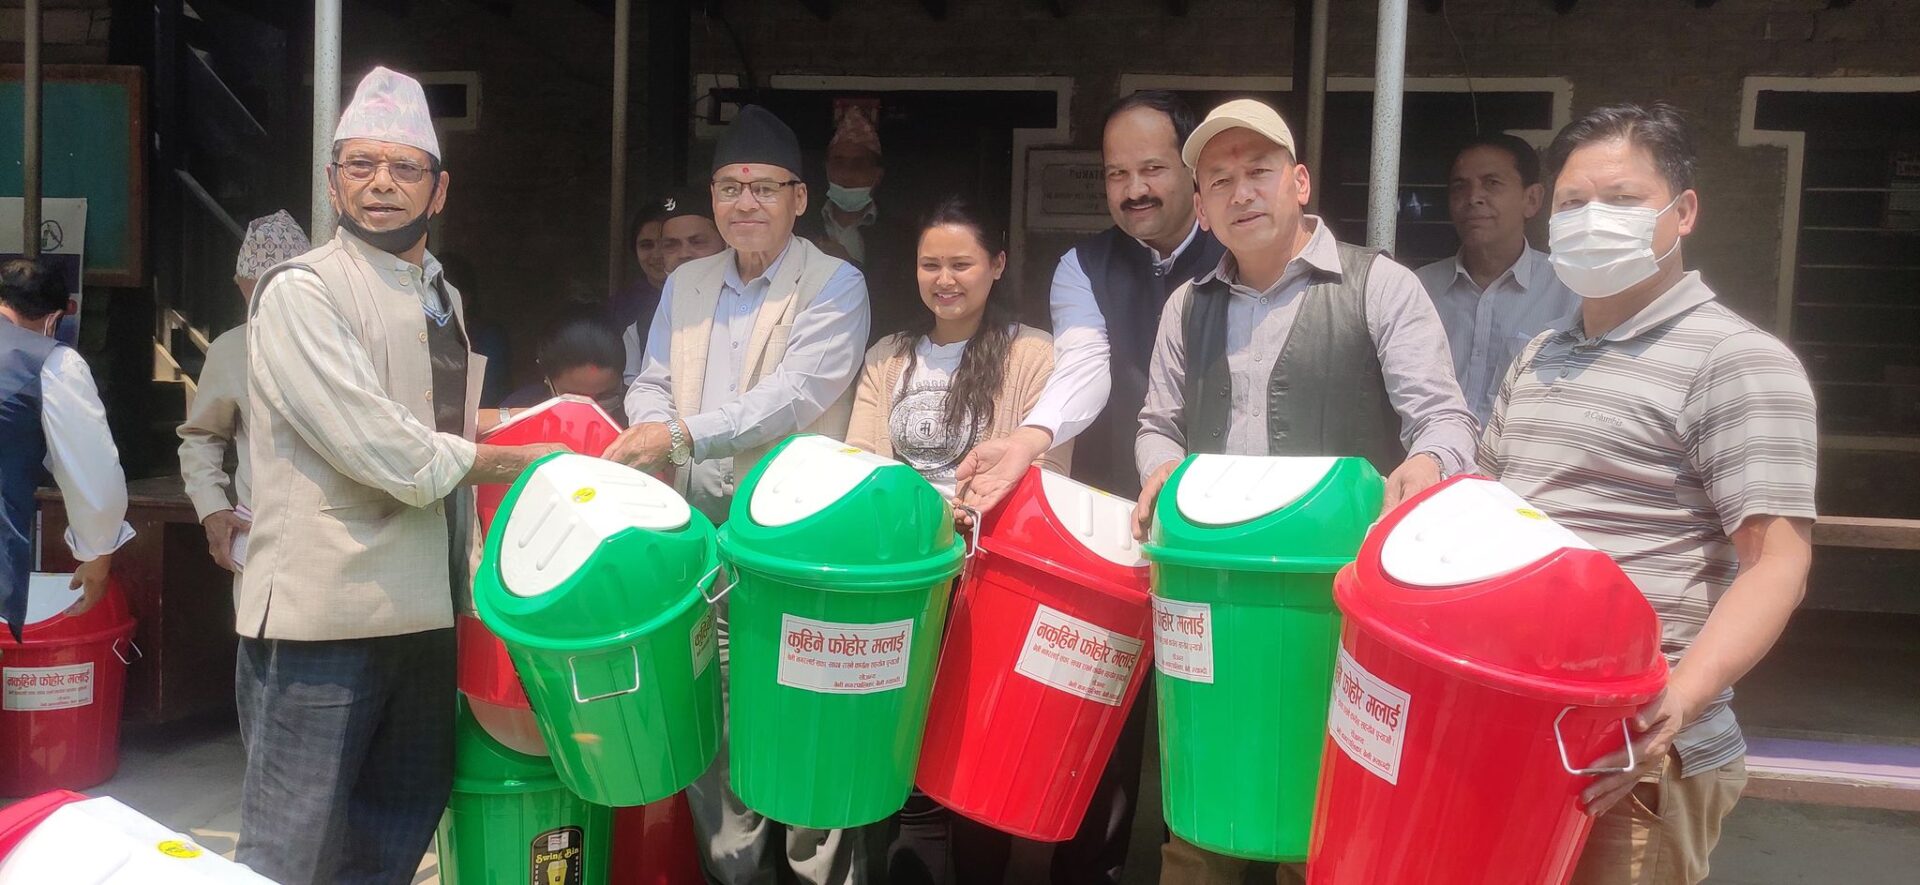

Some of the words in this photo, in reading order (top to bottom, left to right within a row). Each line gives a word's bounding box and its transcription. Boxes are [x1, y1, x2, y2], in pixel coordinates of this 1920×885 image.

[1176, 613, 1205, 638] मलाई
[787, 628, 825, 654] कुहिने
[828, 633, 870, 656] फोहोर
[871, 630, 906, 654] मलाई
[1036, 622, 1081, 651] नकुहिने
[1080, 636, 1113, 663] फोहोर
[1111, 649, 1139, 671] मलाई
[39, 673, 65, 687] फोहोर
[1342, 670, 1364, 709] फोहोर
[1365, 694, 1401, 732] मलाई
[535, 852, 563, 864] Swing
[564, 847, 579, 858] Bin
